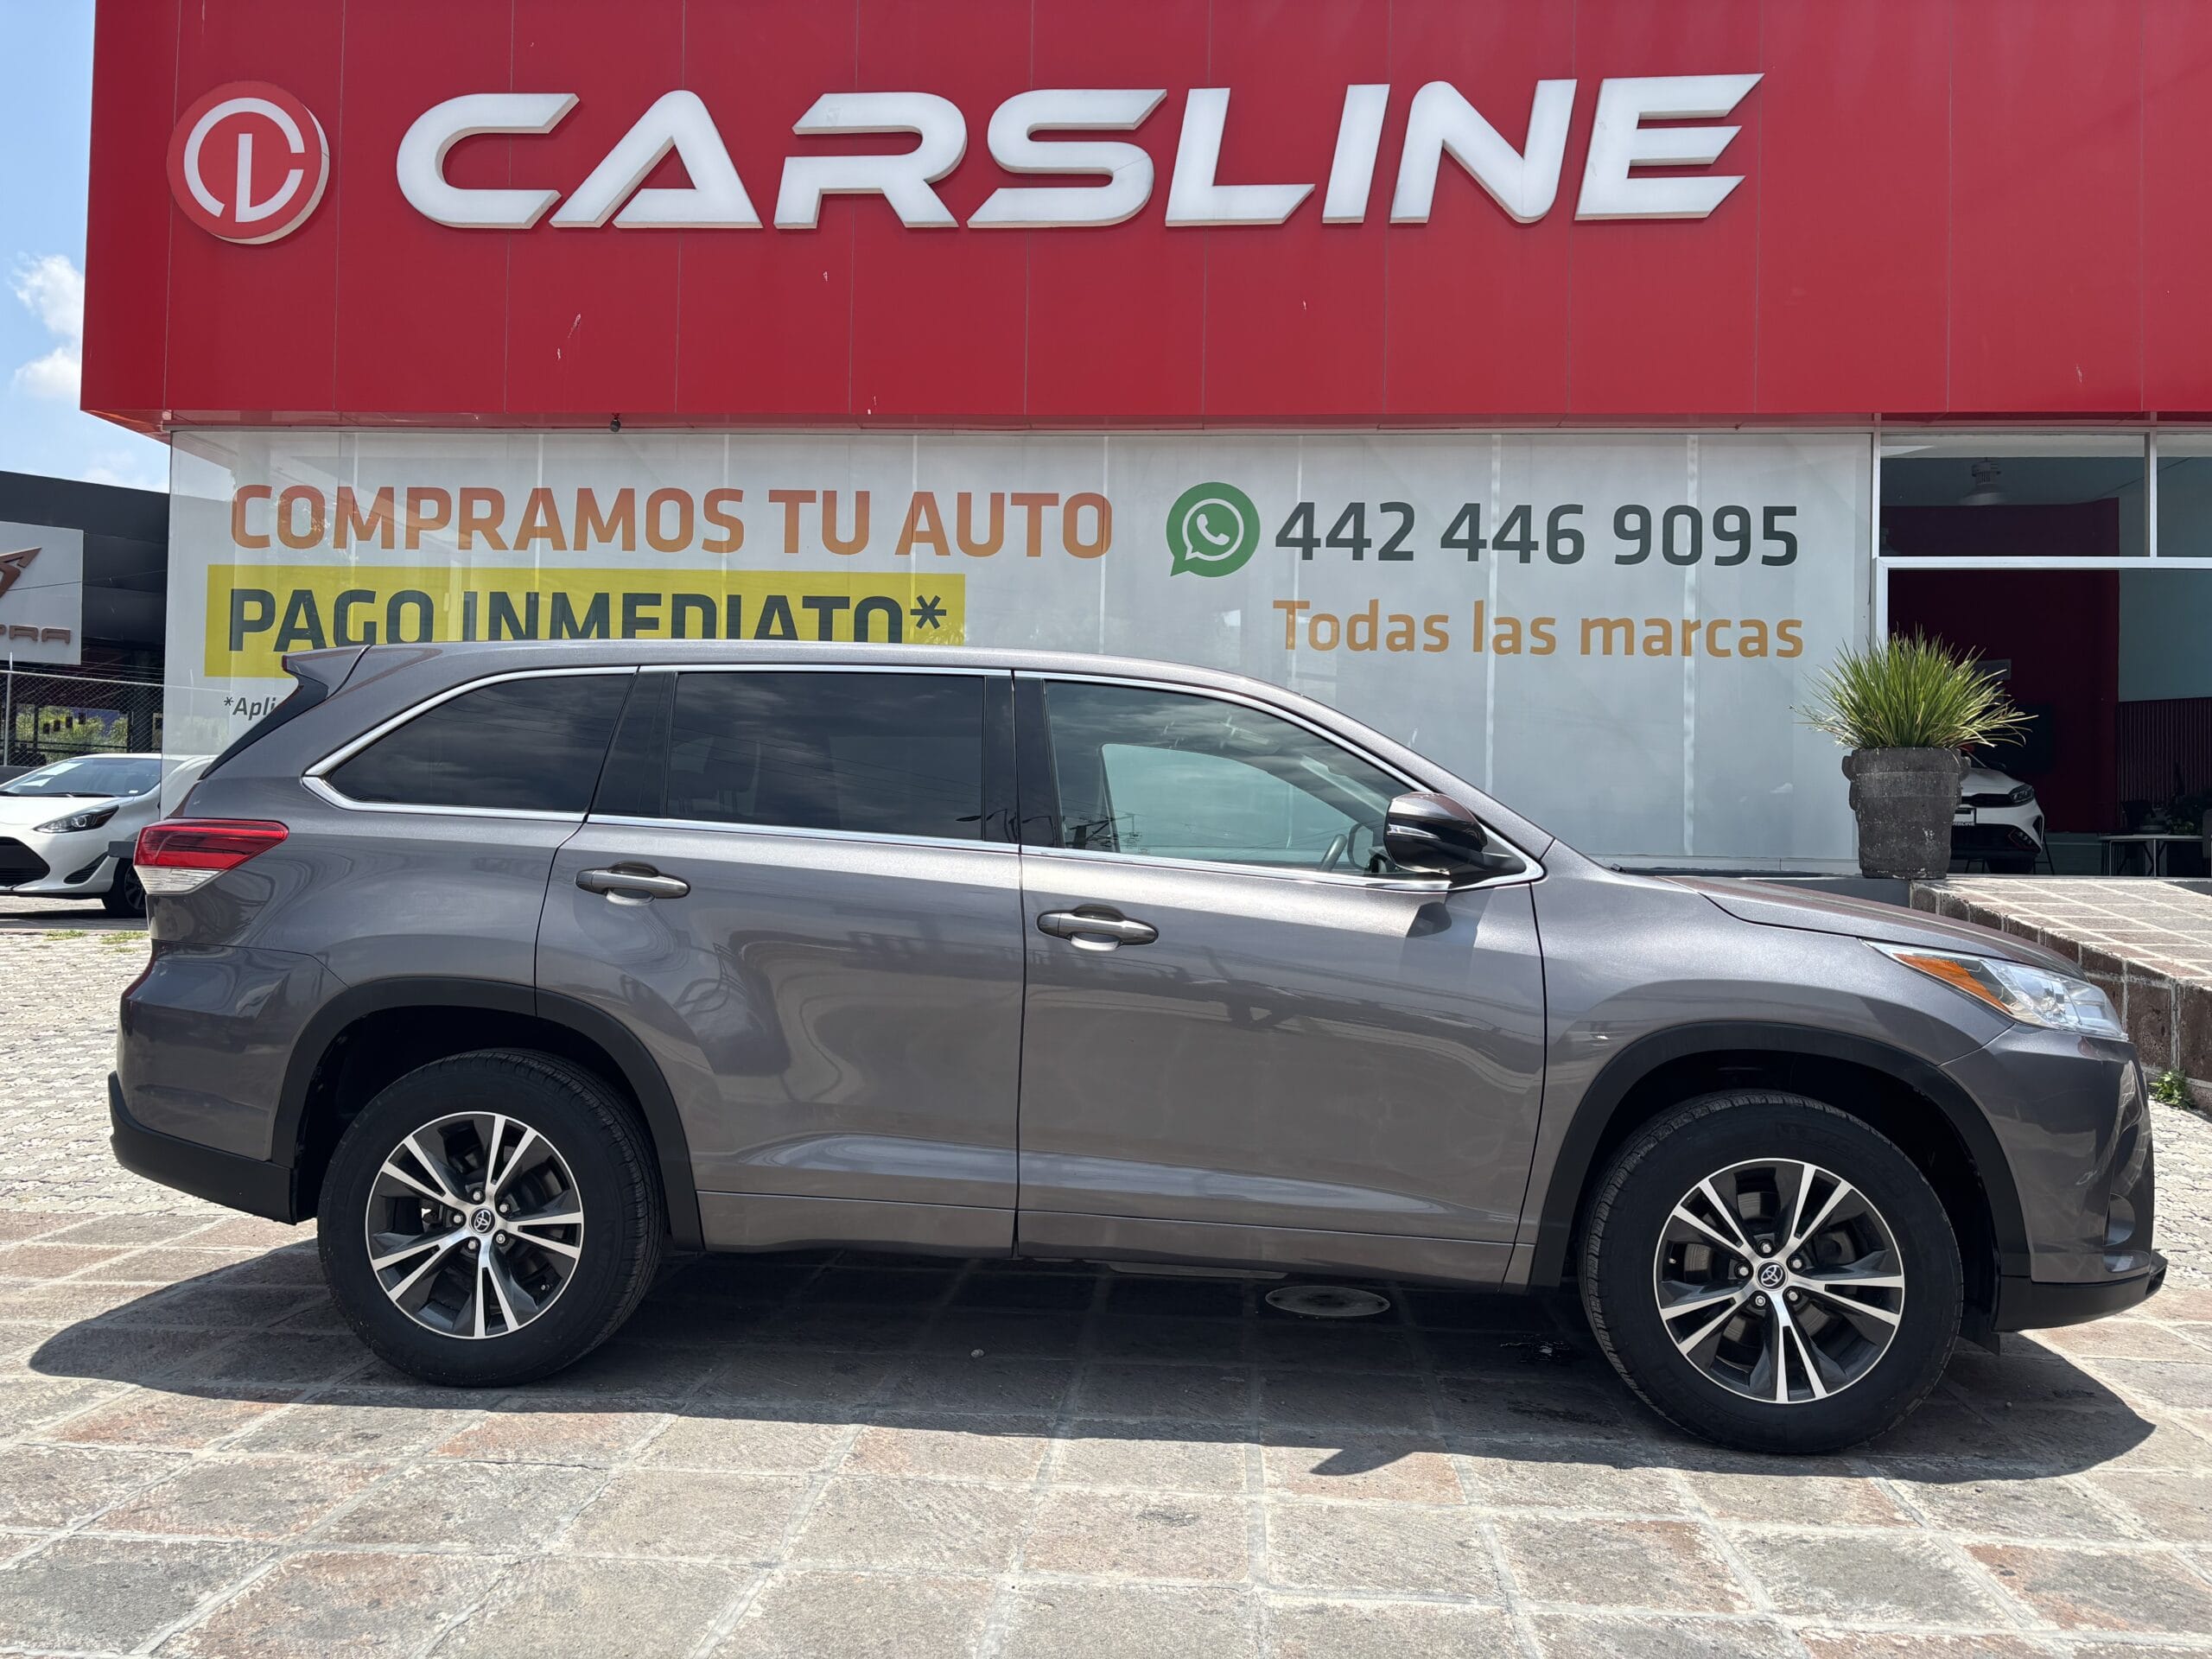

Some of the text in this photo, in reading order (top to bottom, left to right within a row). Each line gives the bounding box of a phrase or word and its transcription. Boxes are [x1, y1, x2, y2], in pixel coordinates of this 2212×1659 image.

[396, 73, 1764, 228] CARSLINE
[230, 485, 1113, 558] COMPRAMOS TU AUTO
[1275, 501, 1798, 566] 442 446 9095
[229, 588, 434, 652] PAGO
[1274, 599, 1803, 658] Todas las marcas
